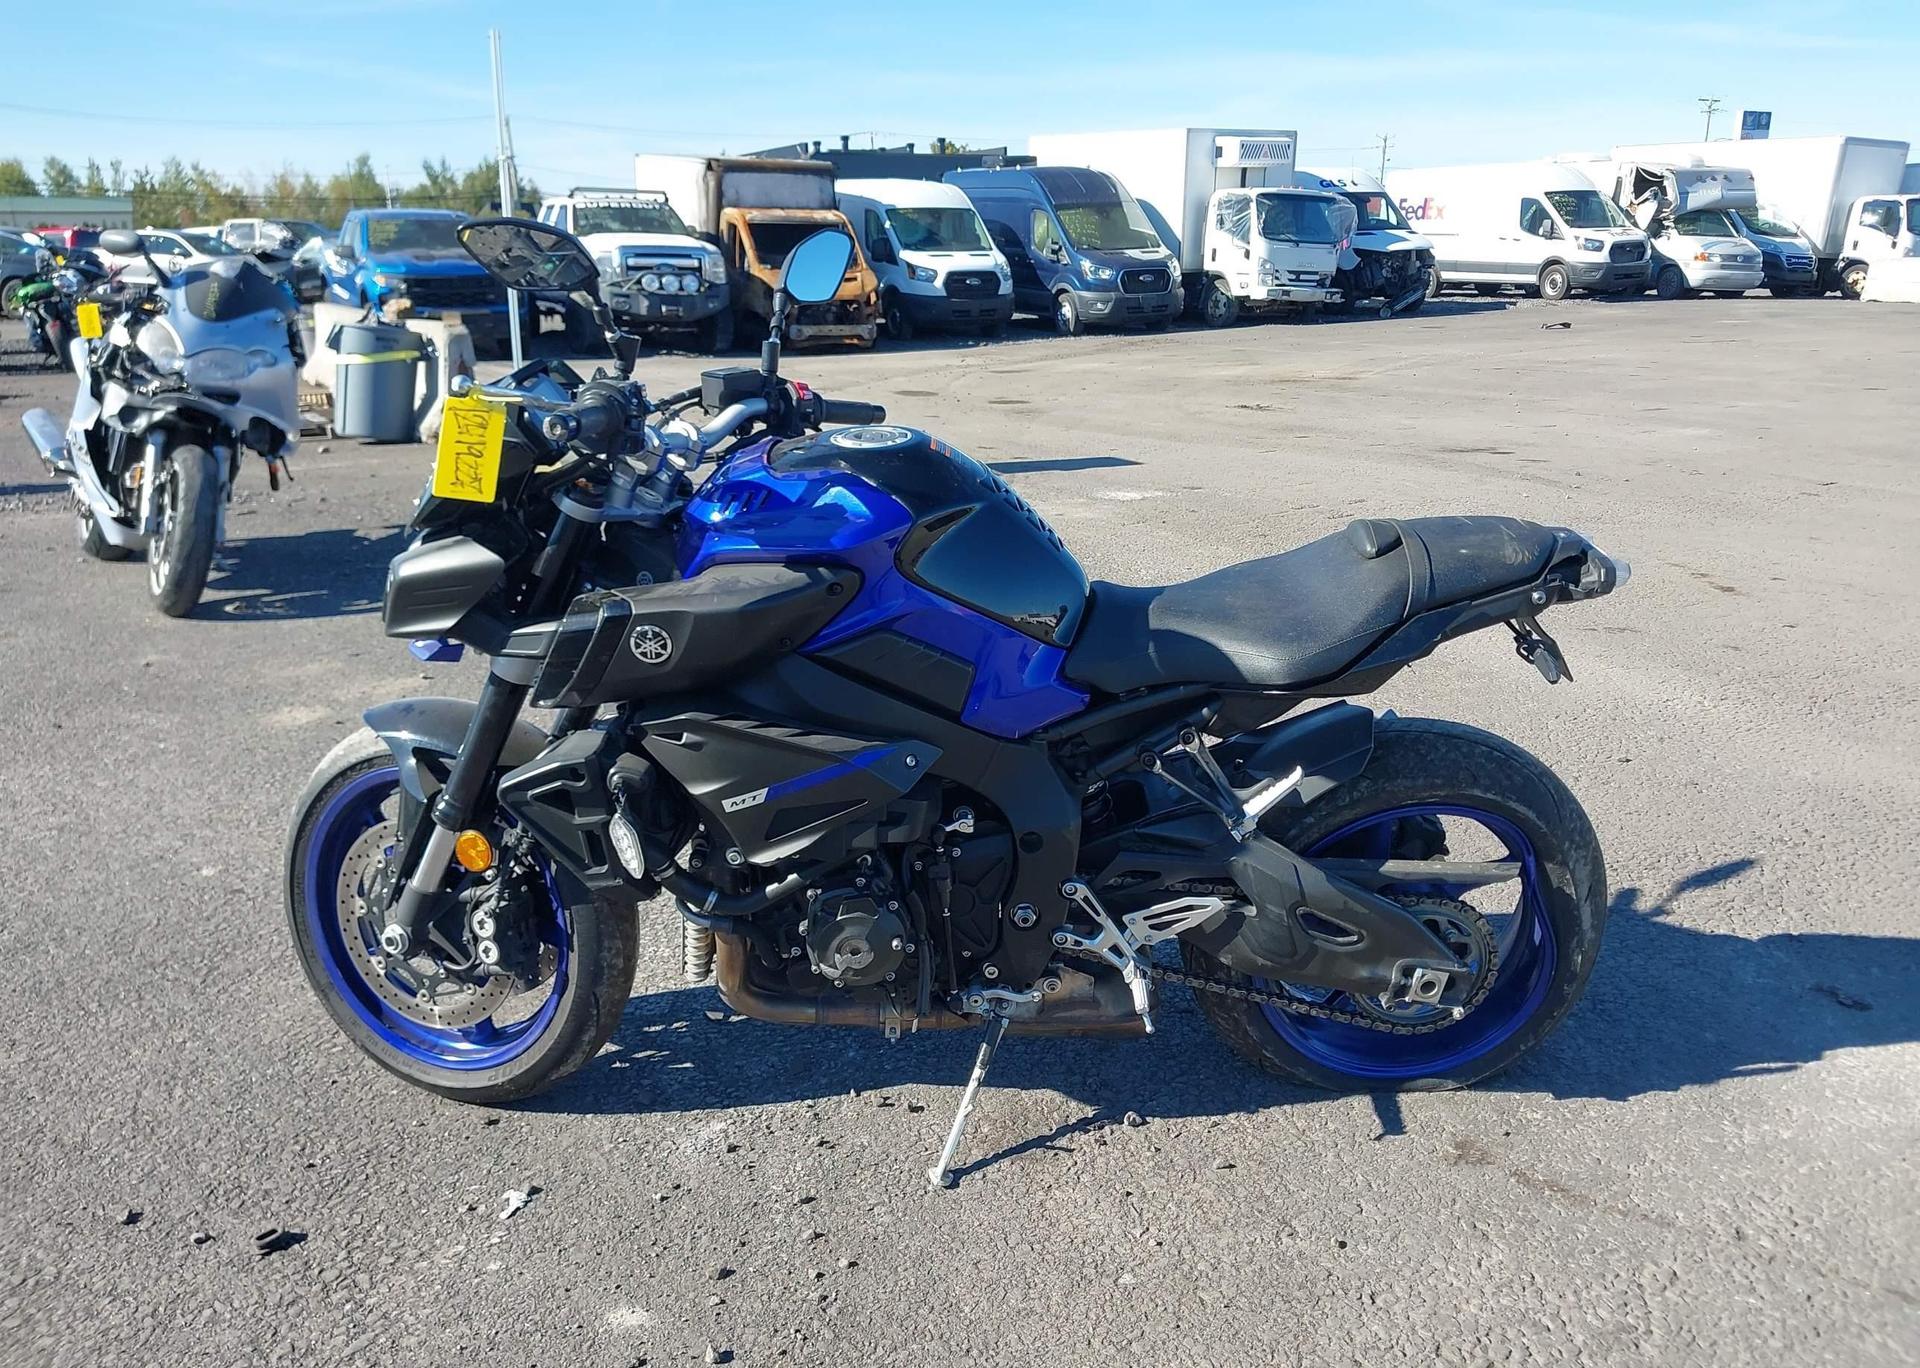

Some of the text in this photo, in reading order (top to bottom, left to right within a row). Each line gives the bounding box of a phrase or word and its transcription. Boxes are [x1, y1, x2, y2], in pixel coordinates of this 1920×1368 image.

[1319, 179, 1347, 188] GLS
[1399, 197, 1445, 220] FedEx
[730, 792, 763, 808] MT
